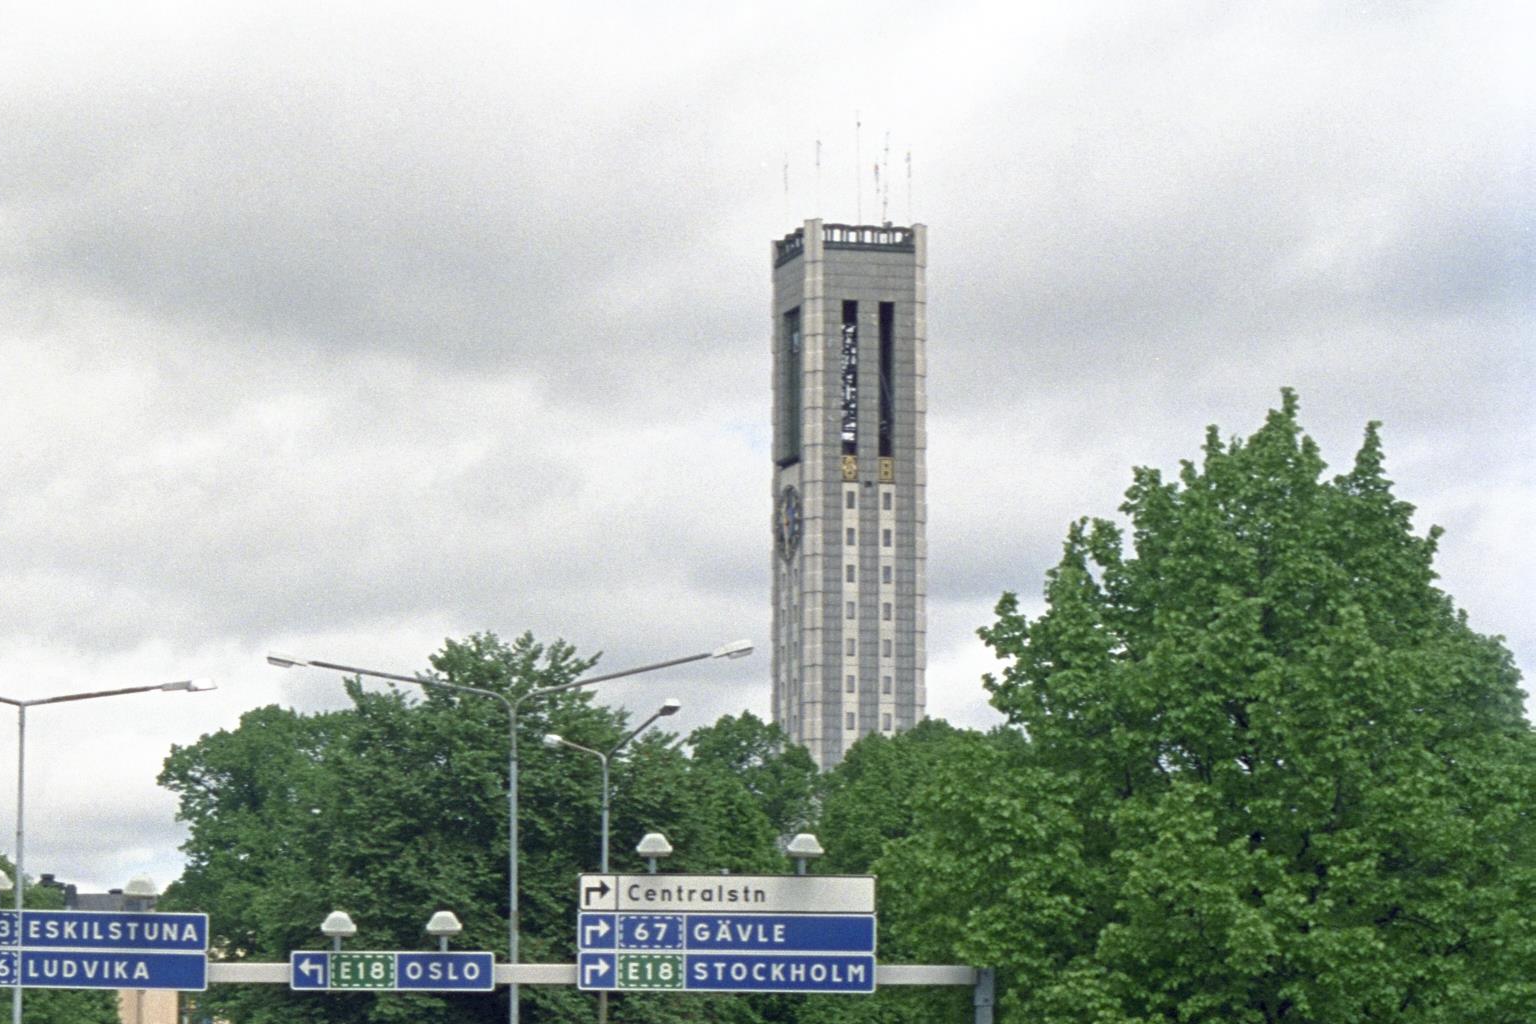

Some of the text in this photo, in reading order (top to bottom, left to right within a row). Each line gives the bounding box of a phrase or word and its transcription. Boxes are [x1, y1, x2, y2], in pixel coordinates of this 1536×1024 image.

[627, 884, 766, 903] Centralstn
[28, 920, 199, 942] ESKILSTUNA
[633, 919, 787, 943] 67 GÄVLE
[28, 959, 150, 980] LUDVIKA
[340, 961, 481, 981] E18 OSLO
[627, 962, 866, 982] E18 STOCKHOLM
